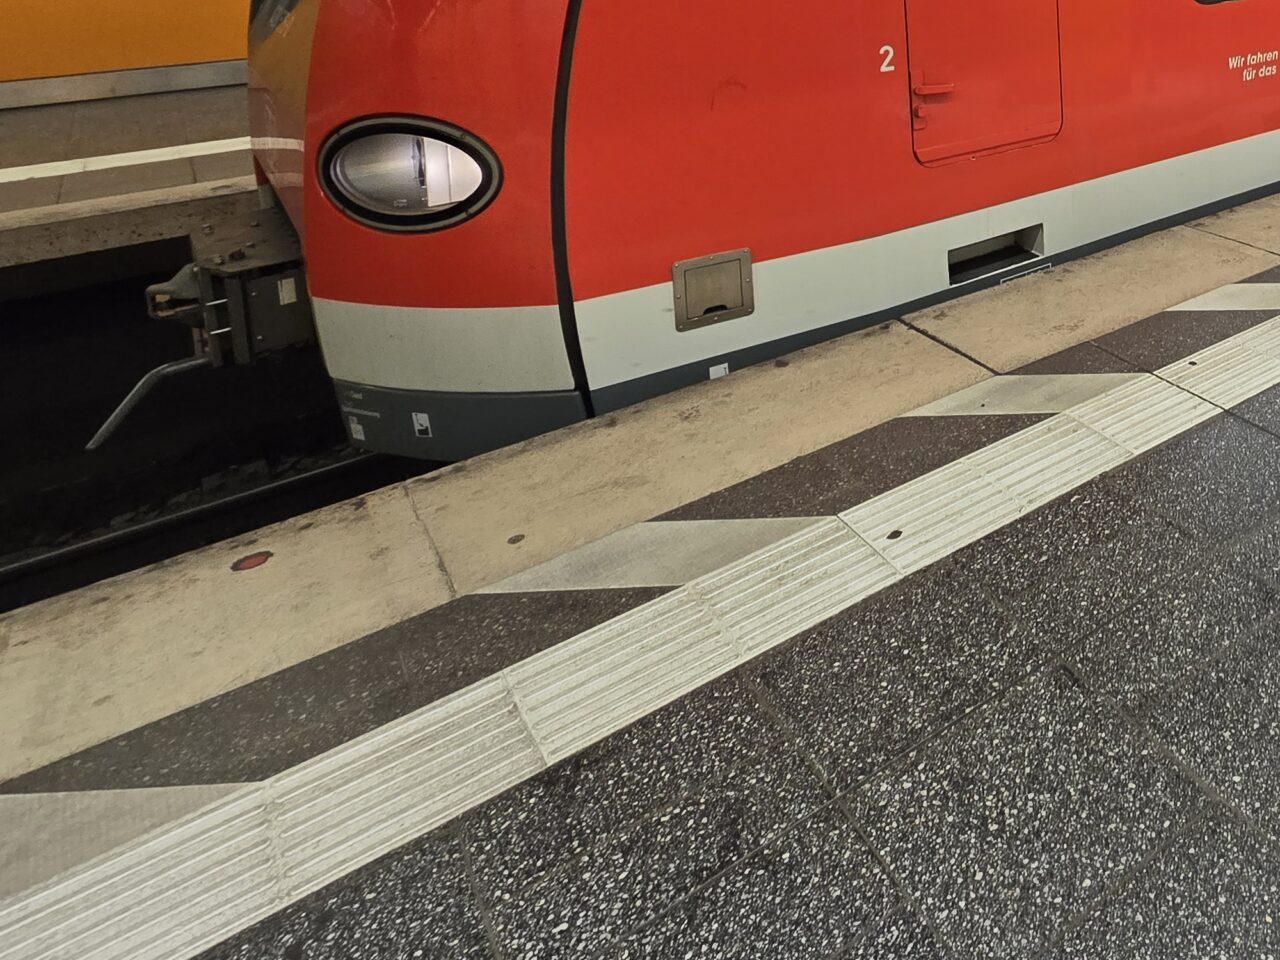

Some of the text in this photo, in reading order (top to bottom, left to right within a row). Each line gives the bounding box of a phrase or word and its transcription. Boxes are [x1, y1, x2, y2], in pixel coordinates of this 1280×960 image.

[879, 45, 895, 73] 2
[1228, 50, 1279, 70] Wir fahren
[1242, 64, 1277, 82] für das
